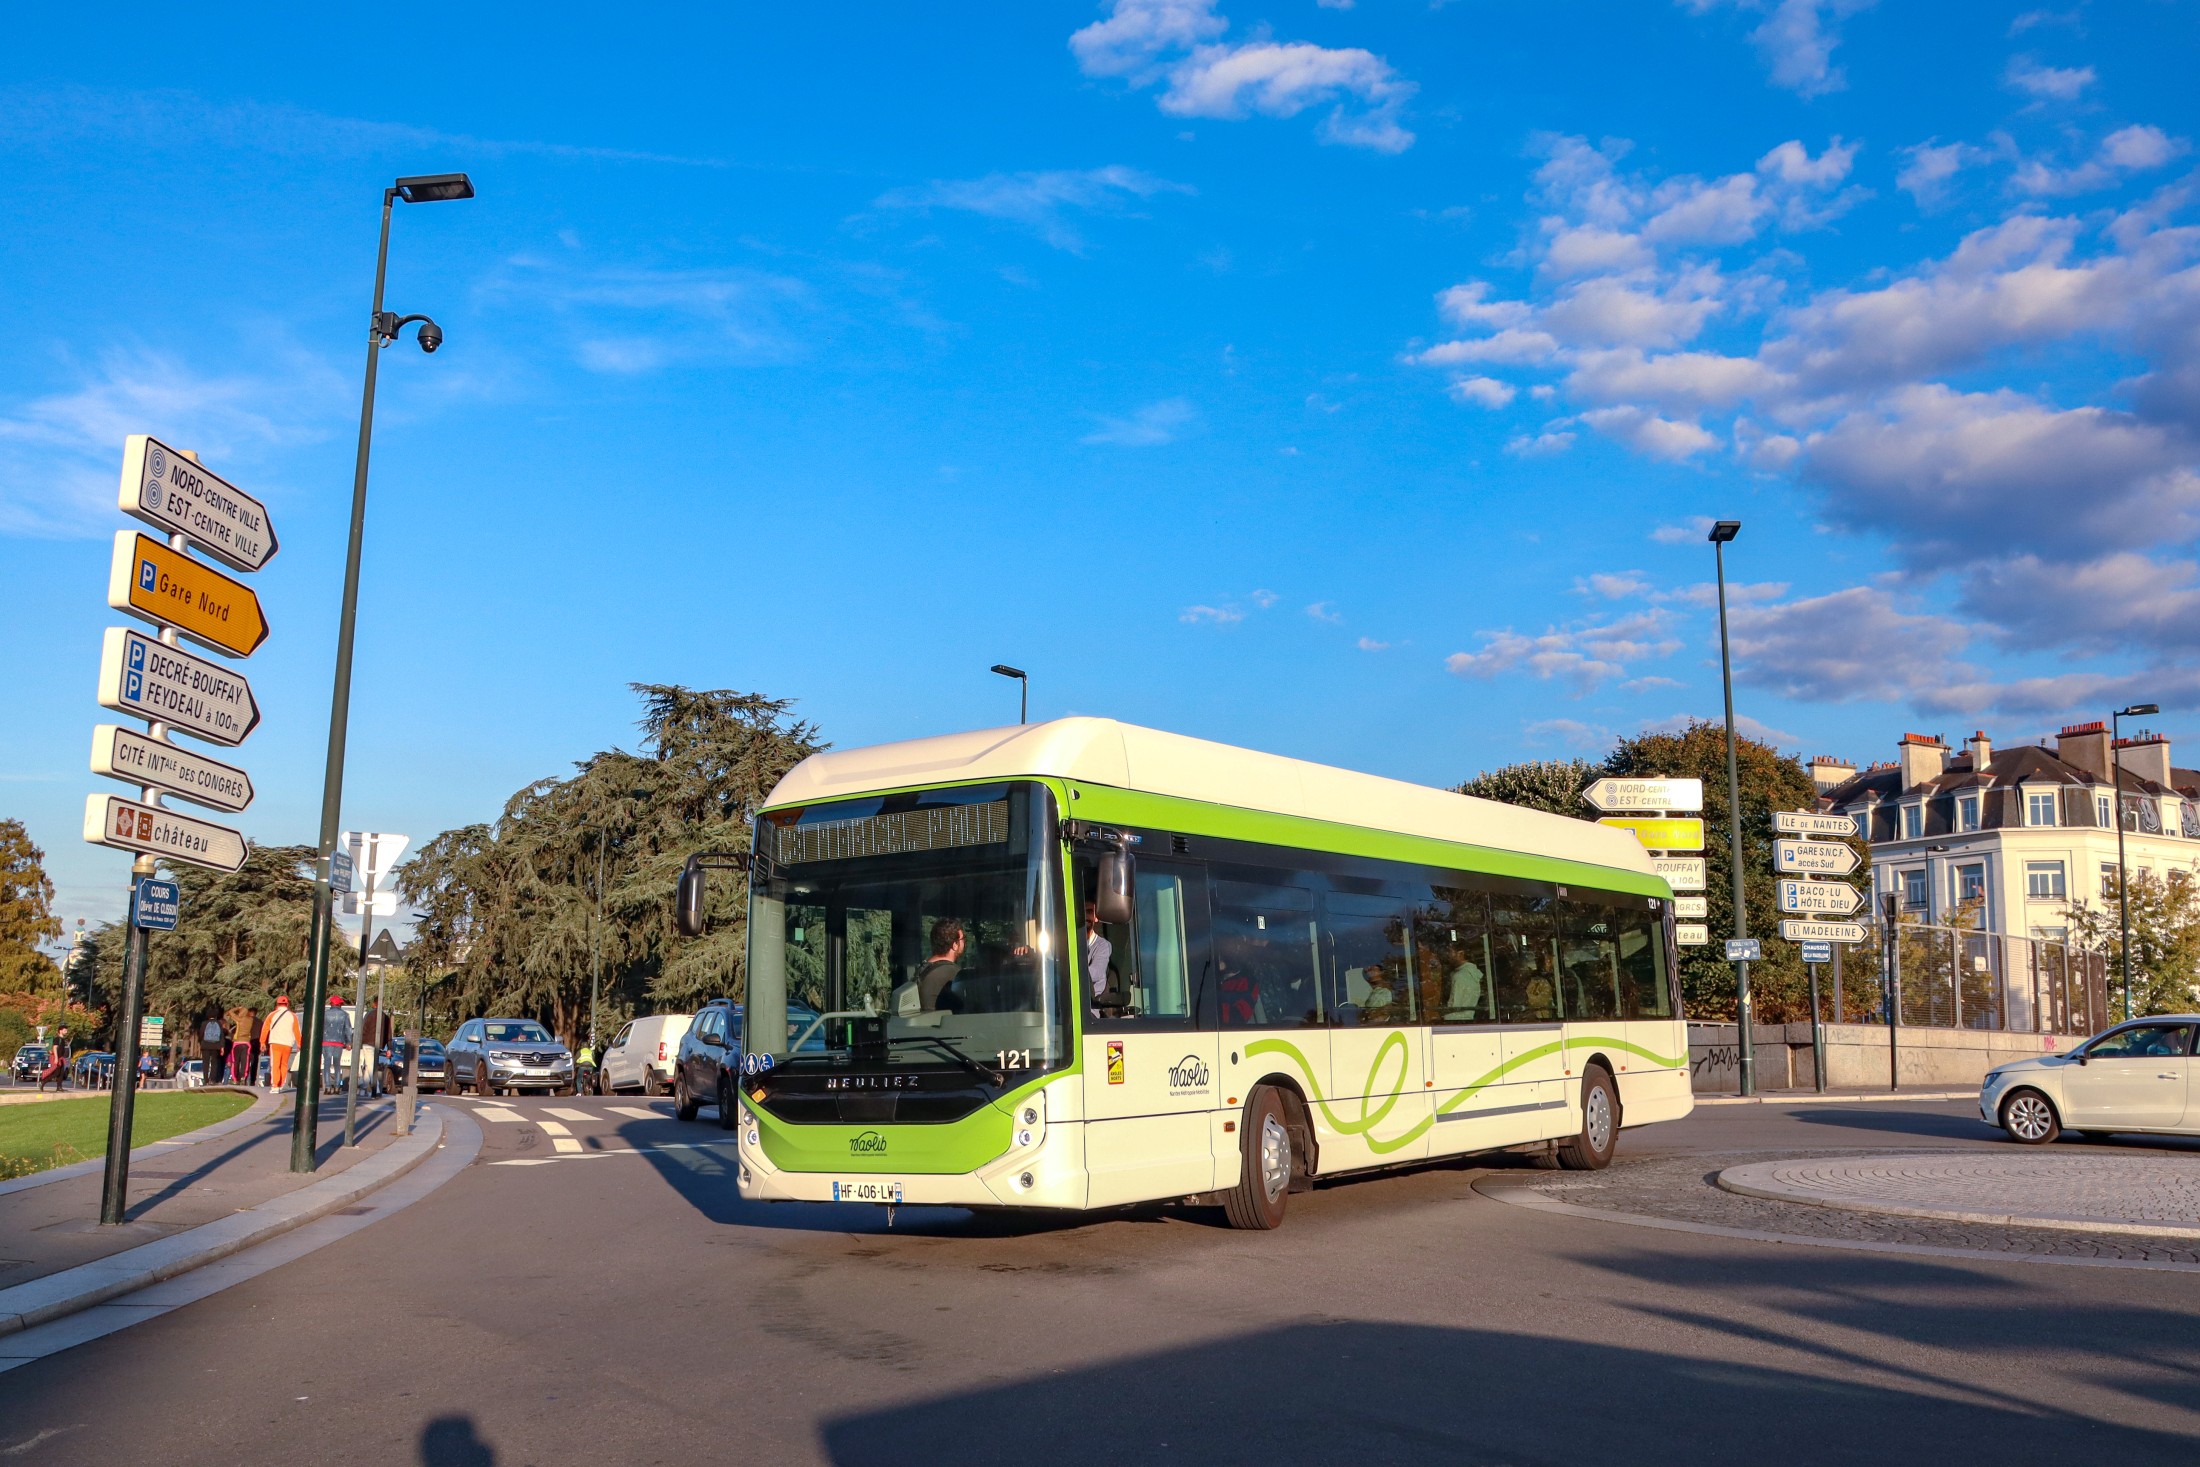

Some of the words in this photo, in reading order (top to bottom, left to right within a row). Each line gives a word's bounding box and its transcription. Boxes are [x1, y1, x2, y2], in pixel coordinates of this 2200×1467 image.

[170, 465, 238, 519] NORD-CENTRE
[239, 507, 260, 532] VILLE
[235, 532, 258, 558] VILLE
[142, 565, 154, 586] P
[159, 573, 192, 604] Gare
[198, 591, 230, 622] Nord
[131, 643, 143, 667] P
[149, 653, 243, 705] DECRÉ-BOUFFAY
[127, 673, 140, 697] P
[146, 681, 204, 719] FEYDEAU
[205, 707, 212, 723] à
[120, 743, 145, 766] CITÉ
[179, 766, 196, 783] DES
[198, 770, 243, 798] CONGRÈS
[1619, 784, 1670, 793] NORD-CENT
[1781, 815, 1796, 827] ÎLE
[1813, 819, 1849, 831] NANTES
[154, 823, 209, 853] château
[1797, 846, 1818, 856] GARE
[1798, 859, 1819, 867] accès
[1820, 859, 1835, 869] Sud
[151, 885, 170, 899] COURS
[153, 902, 160, 913] DE
[1647, 897, 1657, 910] 121
[1800, 896, 1827, 908] HÔTEL
[1830, 899, 1850, 909] DIEU
[1802, 926, 1857, 937] MADELEINE
[996, 1049, 1031, 1070] 121
[827, 1076, 919, 1088] NEULIEZ
